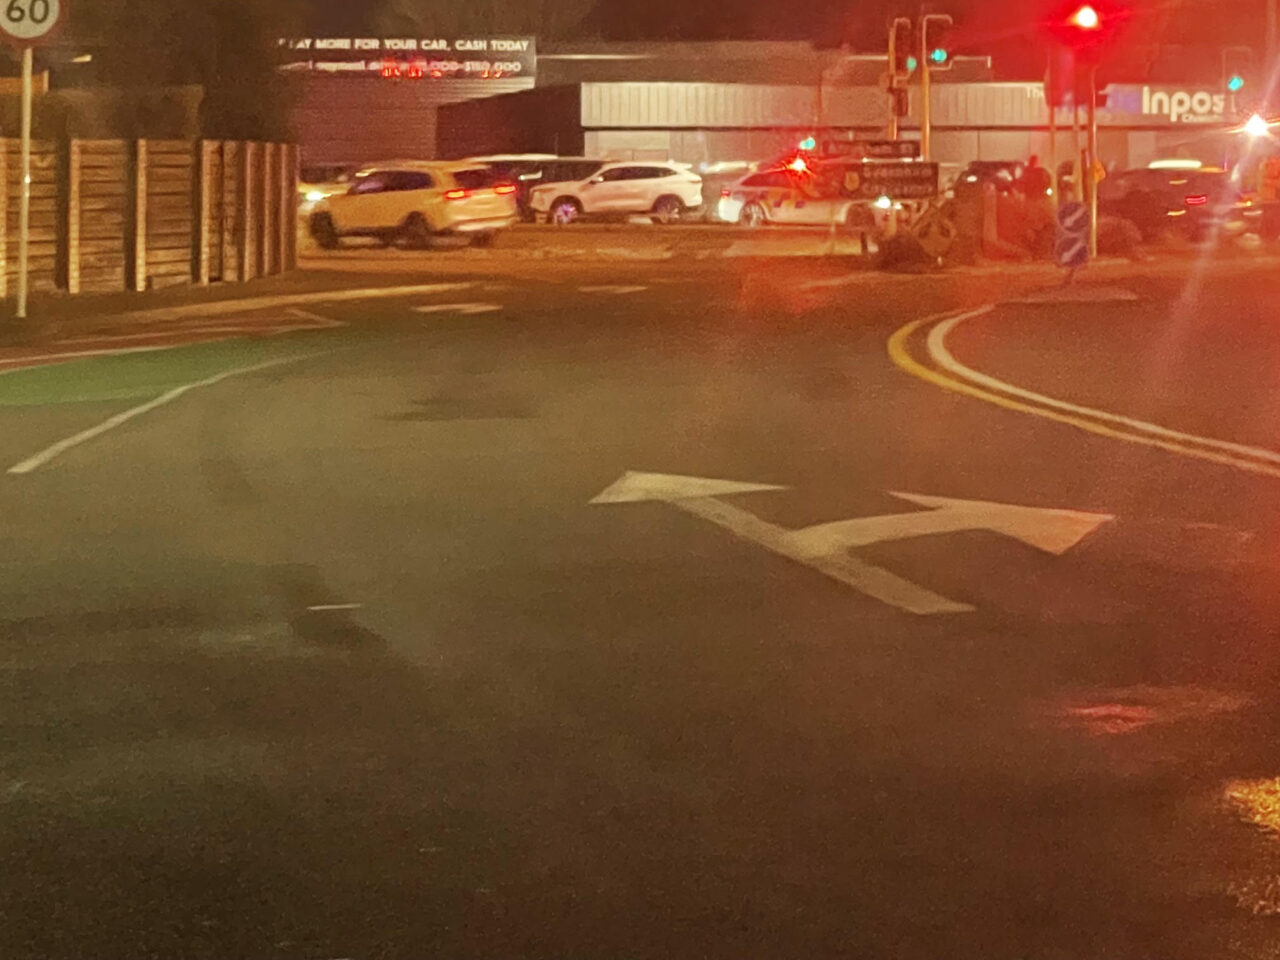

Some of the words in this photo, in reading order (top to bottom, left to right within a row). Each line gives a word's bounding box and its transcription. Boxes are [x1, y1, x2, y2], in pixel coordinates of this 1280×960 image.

[315, 38, 351, 50] MORE
[354, 38, 380, 50] FOR
[384, 38, 417, 51] YOUR
[455, 39, 487, 51] CASH
[490, 39, 529, 52] TODAY
